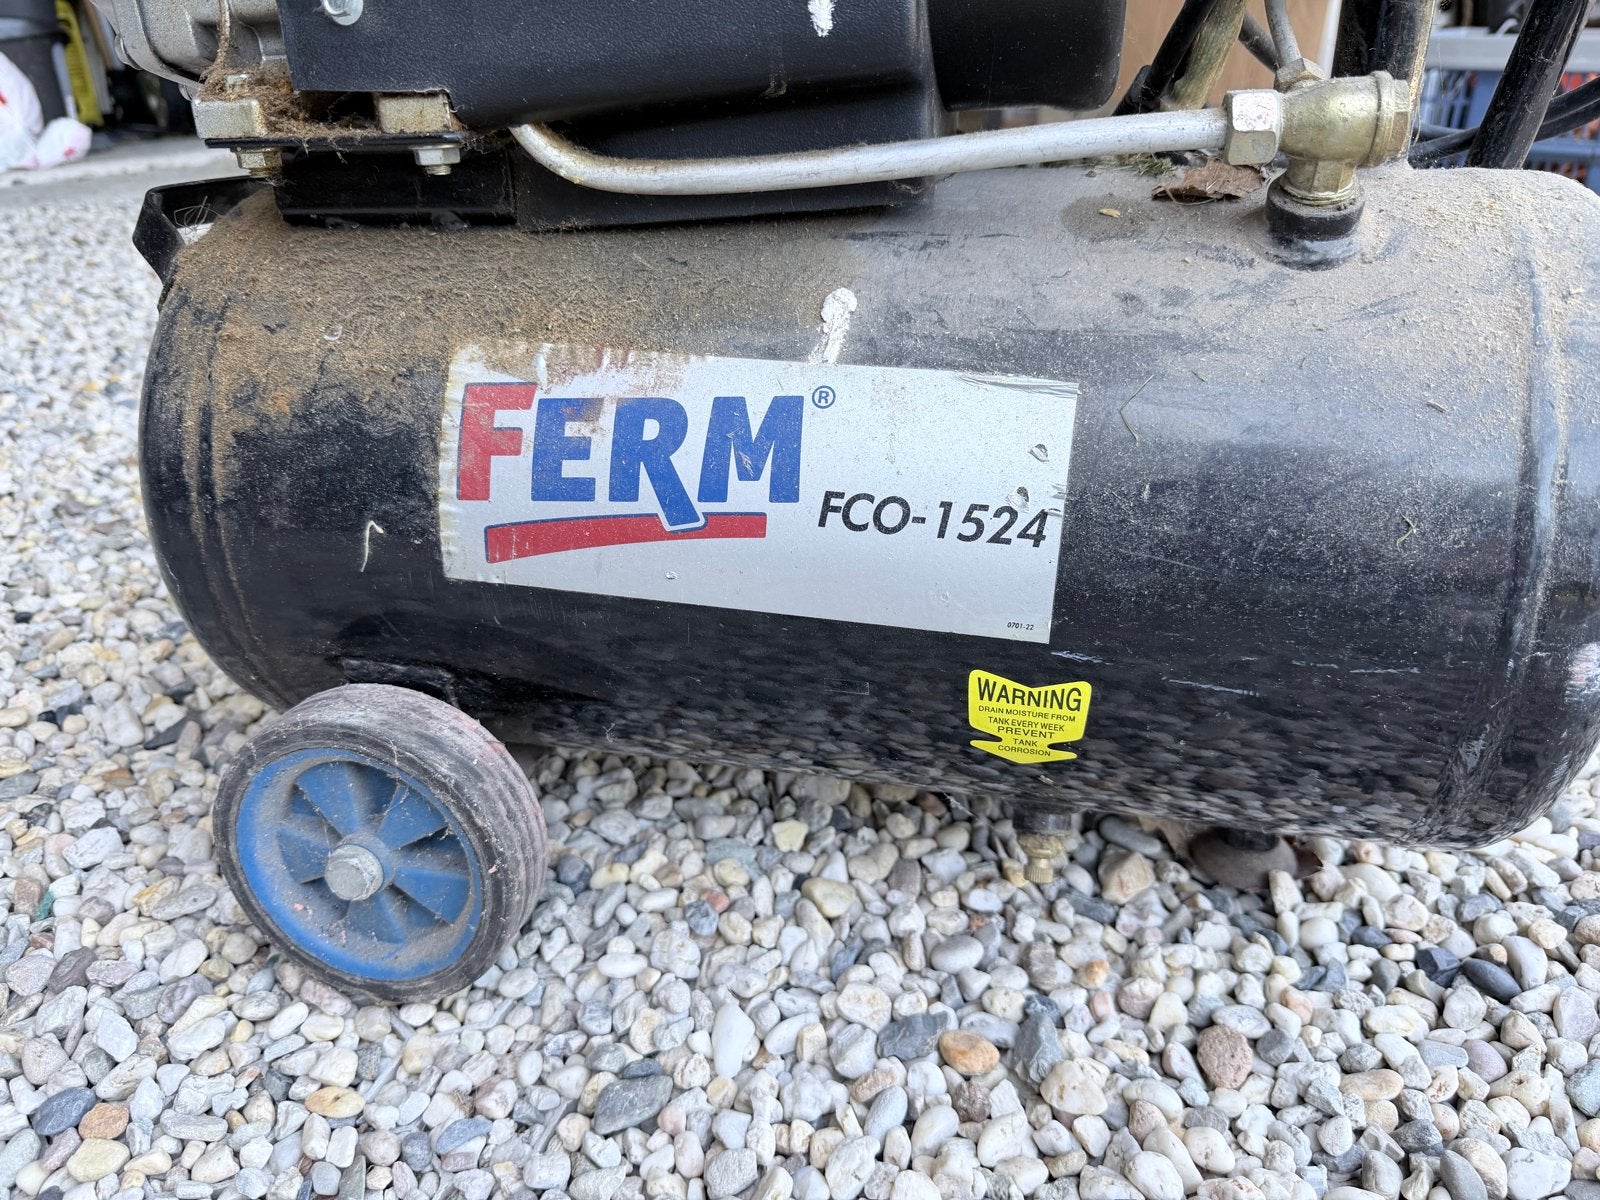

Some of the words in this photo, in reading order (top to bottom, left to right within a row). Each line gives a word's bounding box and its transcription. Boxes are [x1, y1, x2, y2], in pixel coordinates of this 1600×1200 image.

[457, 382, 804, 532] FERM
[818, 491, 1047, 547] FCO-1524
[1007, 621, 1034, 631] 0701-22
[977, 677, 1081, 712] WARNING
[978, 705, 1004, 714] DRAIN
[1005, 709, 1049, 719] MOISTURE
[1051, 714, 1076, 722] FROM
[988, 716, 1010, 726] TANK
[1011, 718, 1038, 729] EVERY
[1040, 722, 1065, 732] WEEK
[997, 725, 1055, 739] PREVENT
[1012, 737, 1038, 747] TANK
[997, 744, 1051, 757] CORROSION
